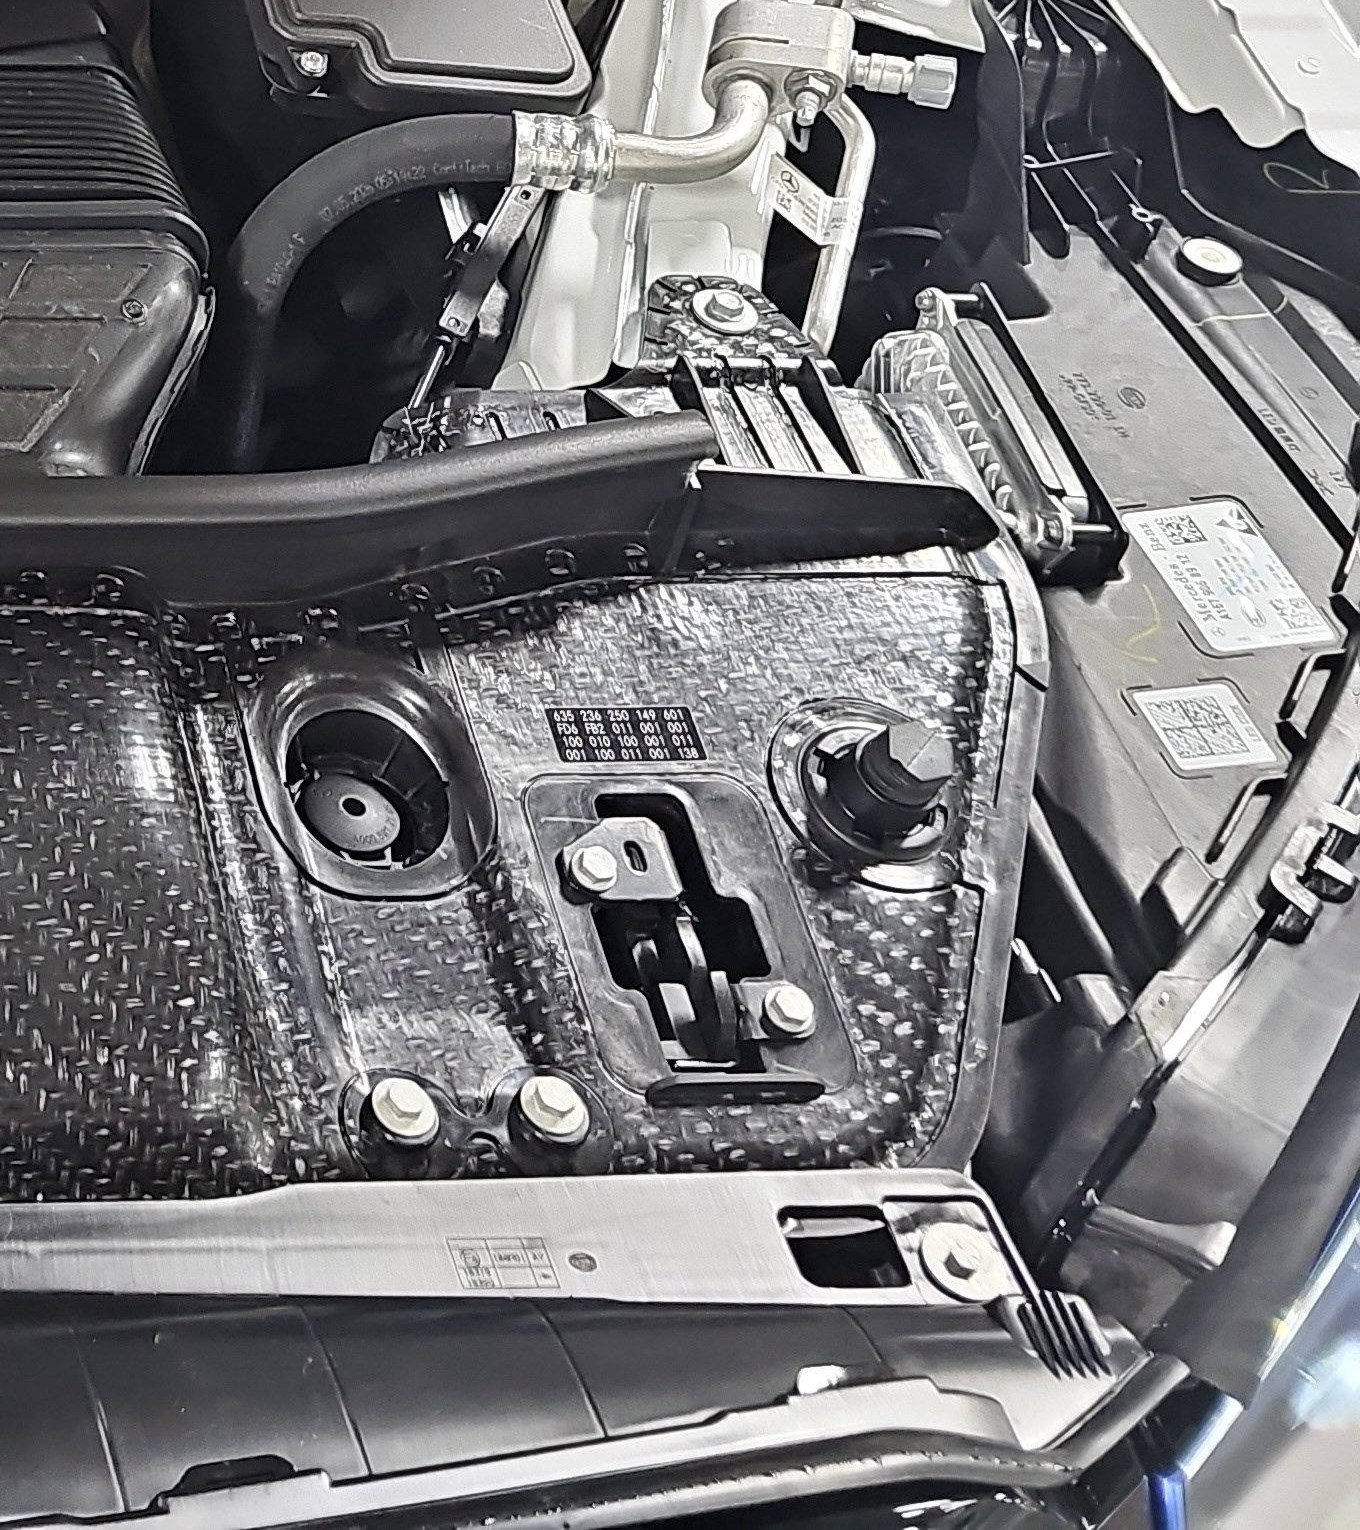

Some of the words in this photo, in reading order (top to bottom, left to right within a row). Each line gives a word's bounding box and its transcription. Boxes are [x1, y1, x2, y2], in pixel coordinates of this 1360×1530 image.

[554, 709, 574, 722] 635
[580, 709, 601, 722] 236
[607, 709, 629, 722] 250
[636, 709, 656, 722] 149
[664, 709, 684, 722] 601
[557, 722, 578, 735] FD6
[612, 722, 632, 735] 011
[640, 722, 661, 735] 001
[668, 722, 688, 735] 001
[563, 734, 582, 747] 100
[589, 734, 610, 747] 010
[618, 734, 638, 747] 100
[644, 734, 665, 747] 001
[672, 734, 693, 747] 011
[566, 748, 586, 760] 001
[595, 748, 615, 760] 100
[621, 748, 642, 760] 011
[649, 748, 669, 760] 001
